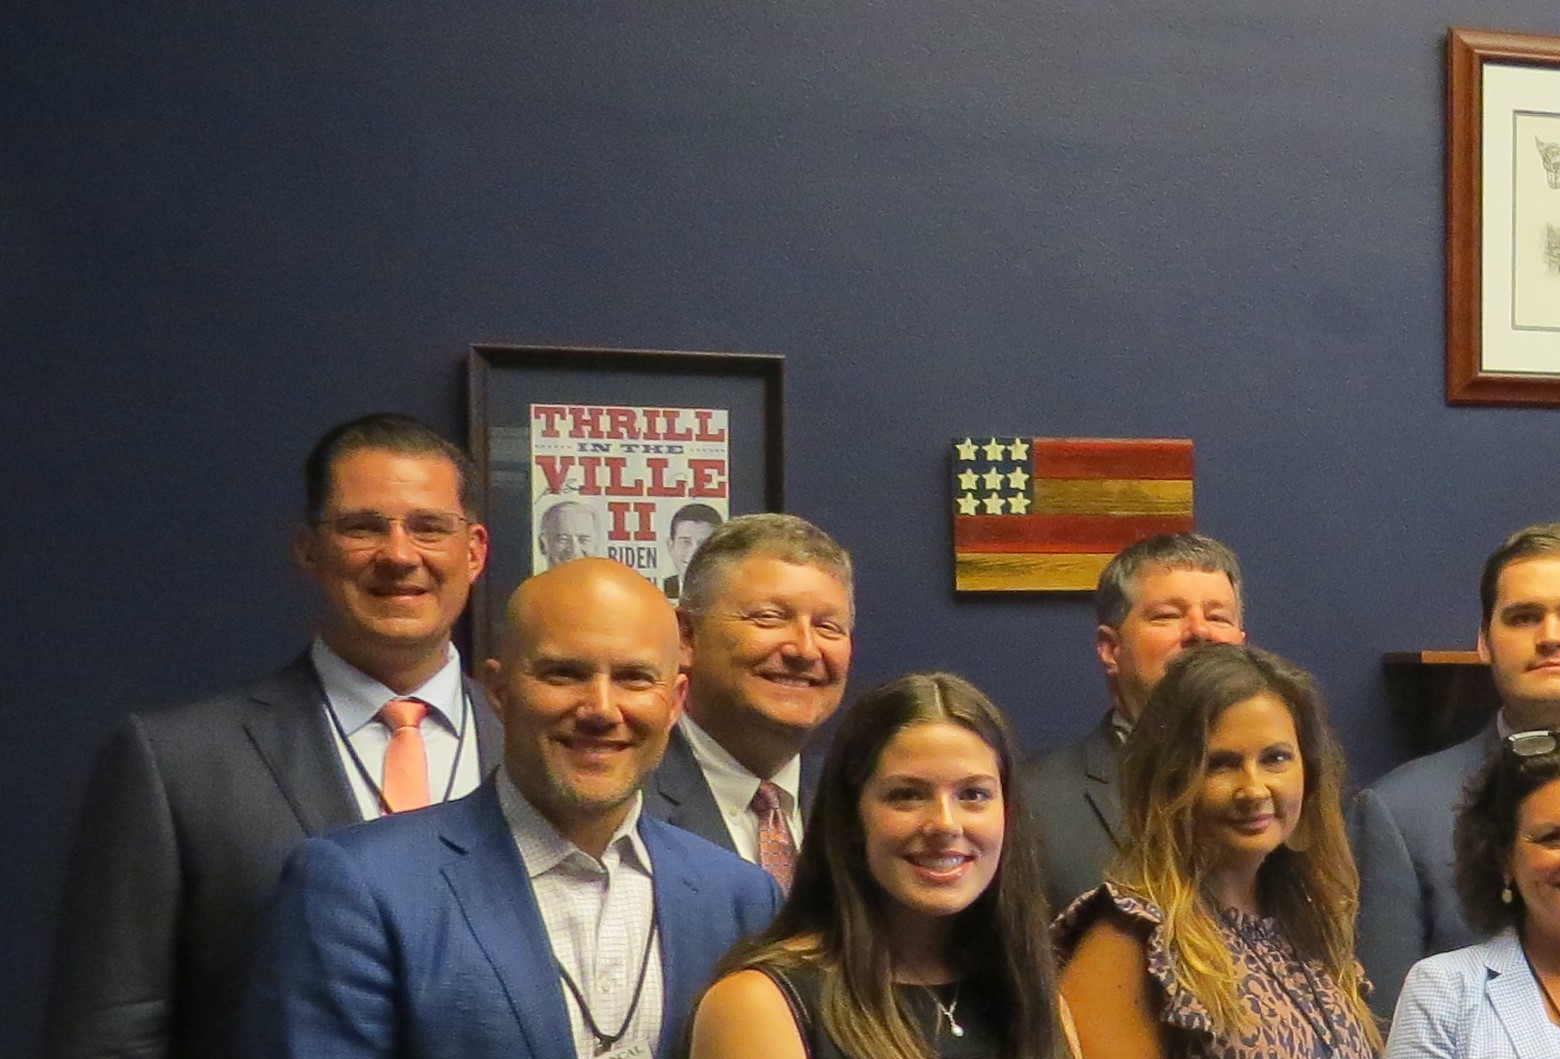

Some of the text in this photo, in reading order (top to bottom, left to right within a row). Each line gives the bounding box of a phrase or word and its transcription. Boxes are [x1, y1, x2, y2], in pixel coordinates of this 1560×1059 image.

[534, 406, 725, 442] THRILL
[577, 442, 685, 454] IN THE
[535, 455, 728, 498] VILLE
[607, 501, 657, 542] II
[607, 546, 657, 569] BIDEN
